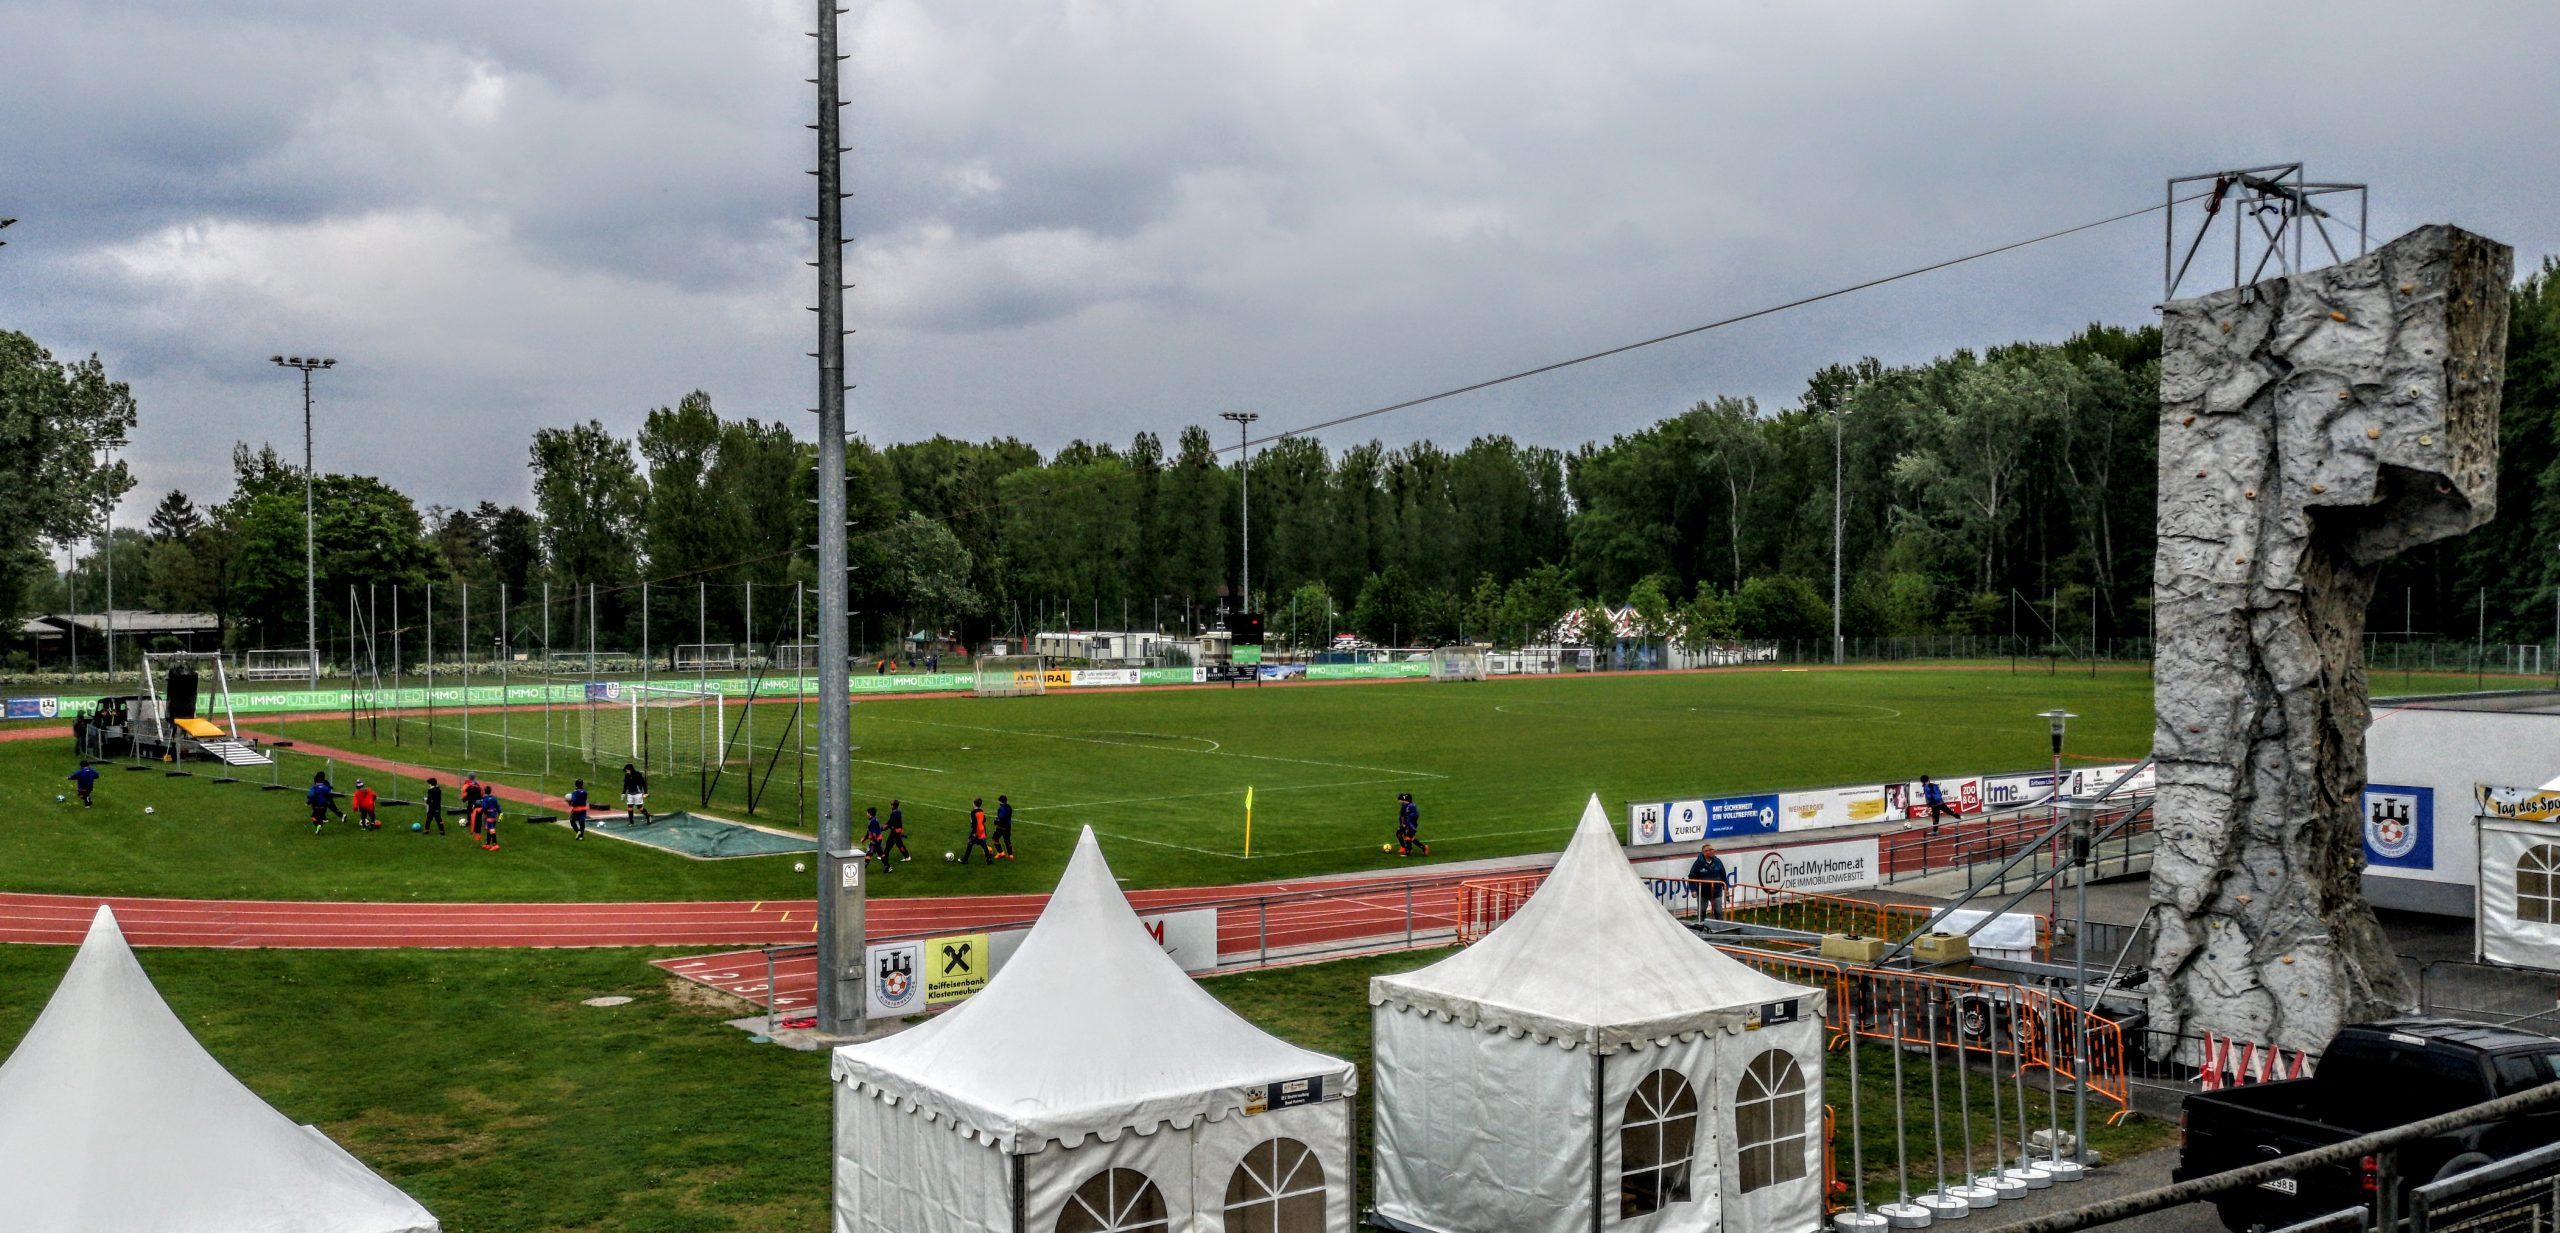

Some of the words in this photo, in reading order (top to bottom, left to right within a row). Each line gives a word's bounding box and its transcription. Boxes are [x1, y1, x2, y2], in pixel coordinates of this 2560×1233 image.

[763, 680, 789, 689] IMMO
[893, 677, 918, 686] IMMO
[955, 676, 974, 684] IMM
[508, 689, 539, 699] IMMO
[251, 695, 286, 705] IMMO
[289, 694, 335, 705] UNITED
[60, 700, 97, 711] IMMO
[1712, 805, 1723, 813] MIT
[1724, 803, 1753, 812] SICHERHEIT
[2496, 801, 2516, 816] Tag
[2519, 799, 2538, 813] des
[1712, 813, 1722, 821] EIN
[1675, 825, 1702, 835] ZURICH
[1785, 879, 1796, 888] DIE
[1797, 871, 1864, 888] IMMOBILIENWEBSITE
[928, 977, 985, 991] Raiffeisenbank
[928, 987, 984, 999] Klosterneubur
